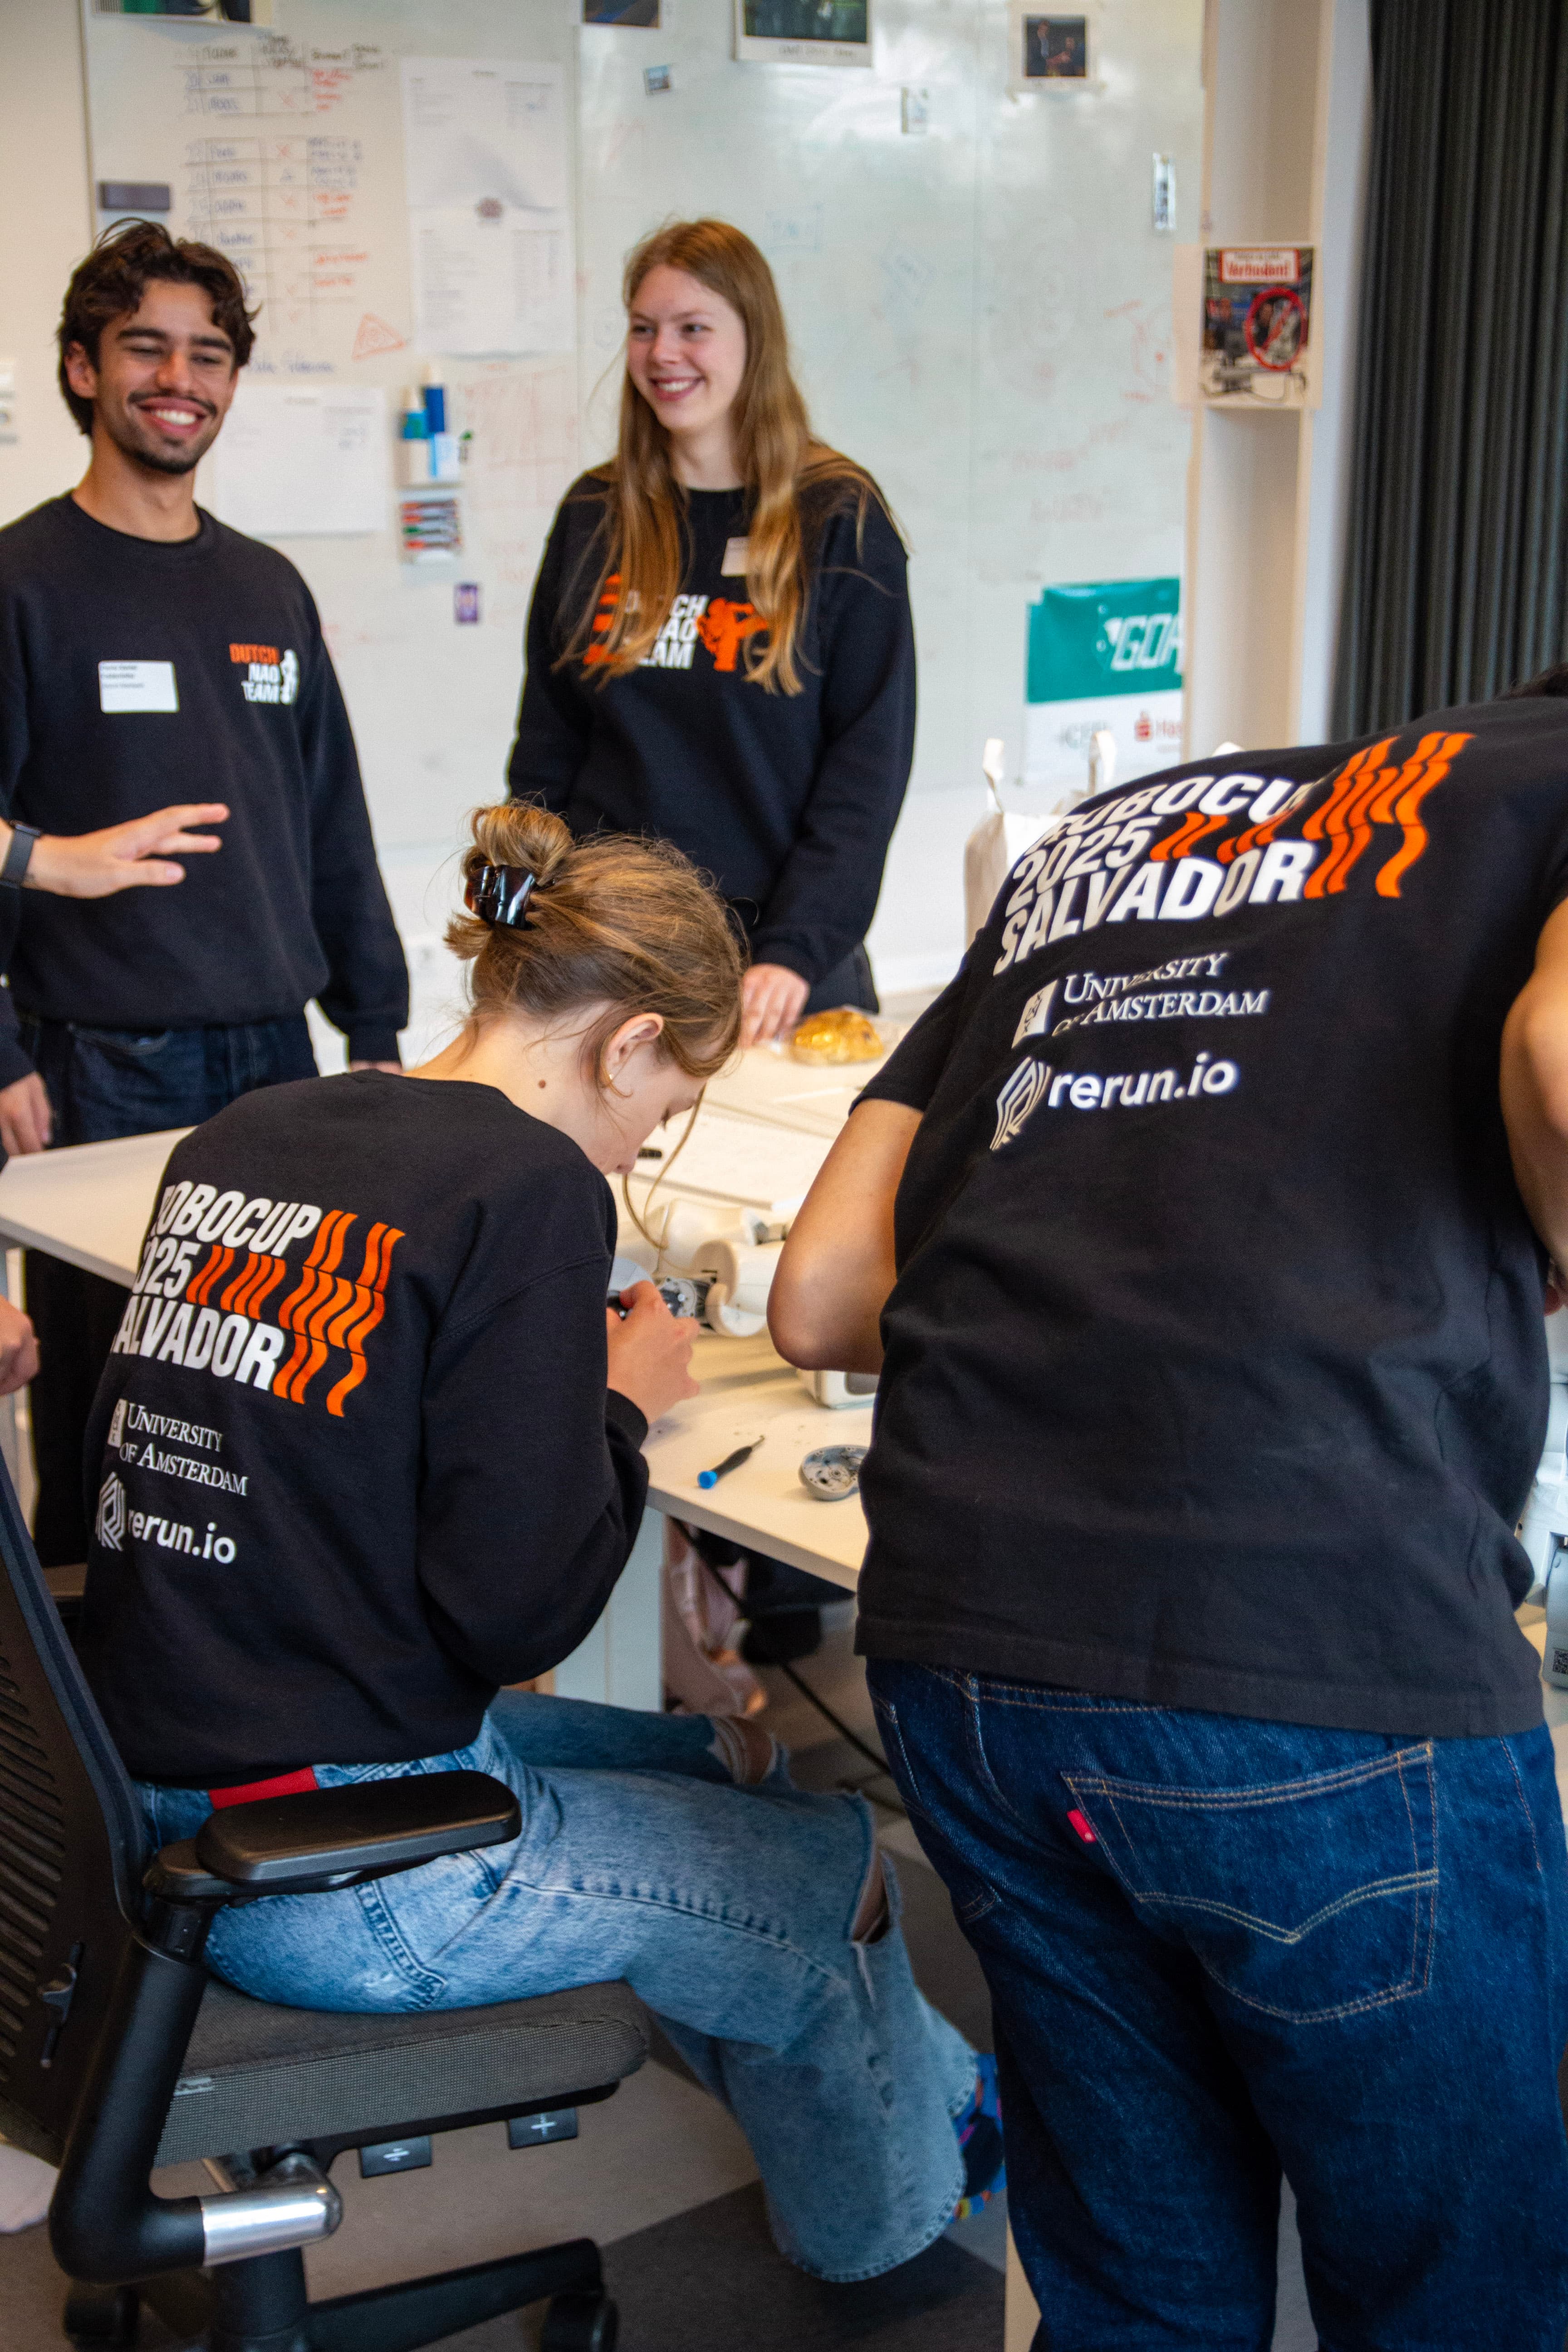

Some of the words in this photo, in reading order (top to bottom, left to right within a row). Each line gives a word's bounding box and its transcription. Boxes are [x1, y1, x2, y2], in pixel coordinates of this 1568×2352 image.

[248, 663, 280, 683] NAO
[638, 641, 693, 669] AM
[241, 680, 280, 703] TEAM
[1024, 774, 1318, 854] ROBOCU
[1004, 816, 1163, 917] 2025
[993, 841, 1320, 976] SALVADOR
[1080, 990, 1269, 1025] AMSTERDAM
[1048, 1051, 1240, 1110] rerun.io
[132, 1236, 202, 1299] 025
[110, 1295, 285, 1391] ALVADOR
[127, 1403, 222, 1452] UNIVERSITY
[119, 1442, 138, 1463] OF
[137, 1442, 249, 1496] AMSTERDAM
